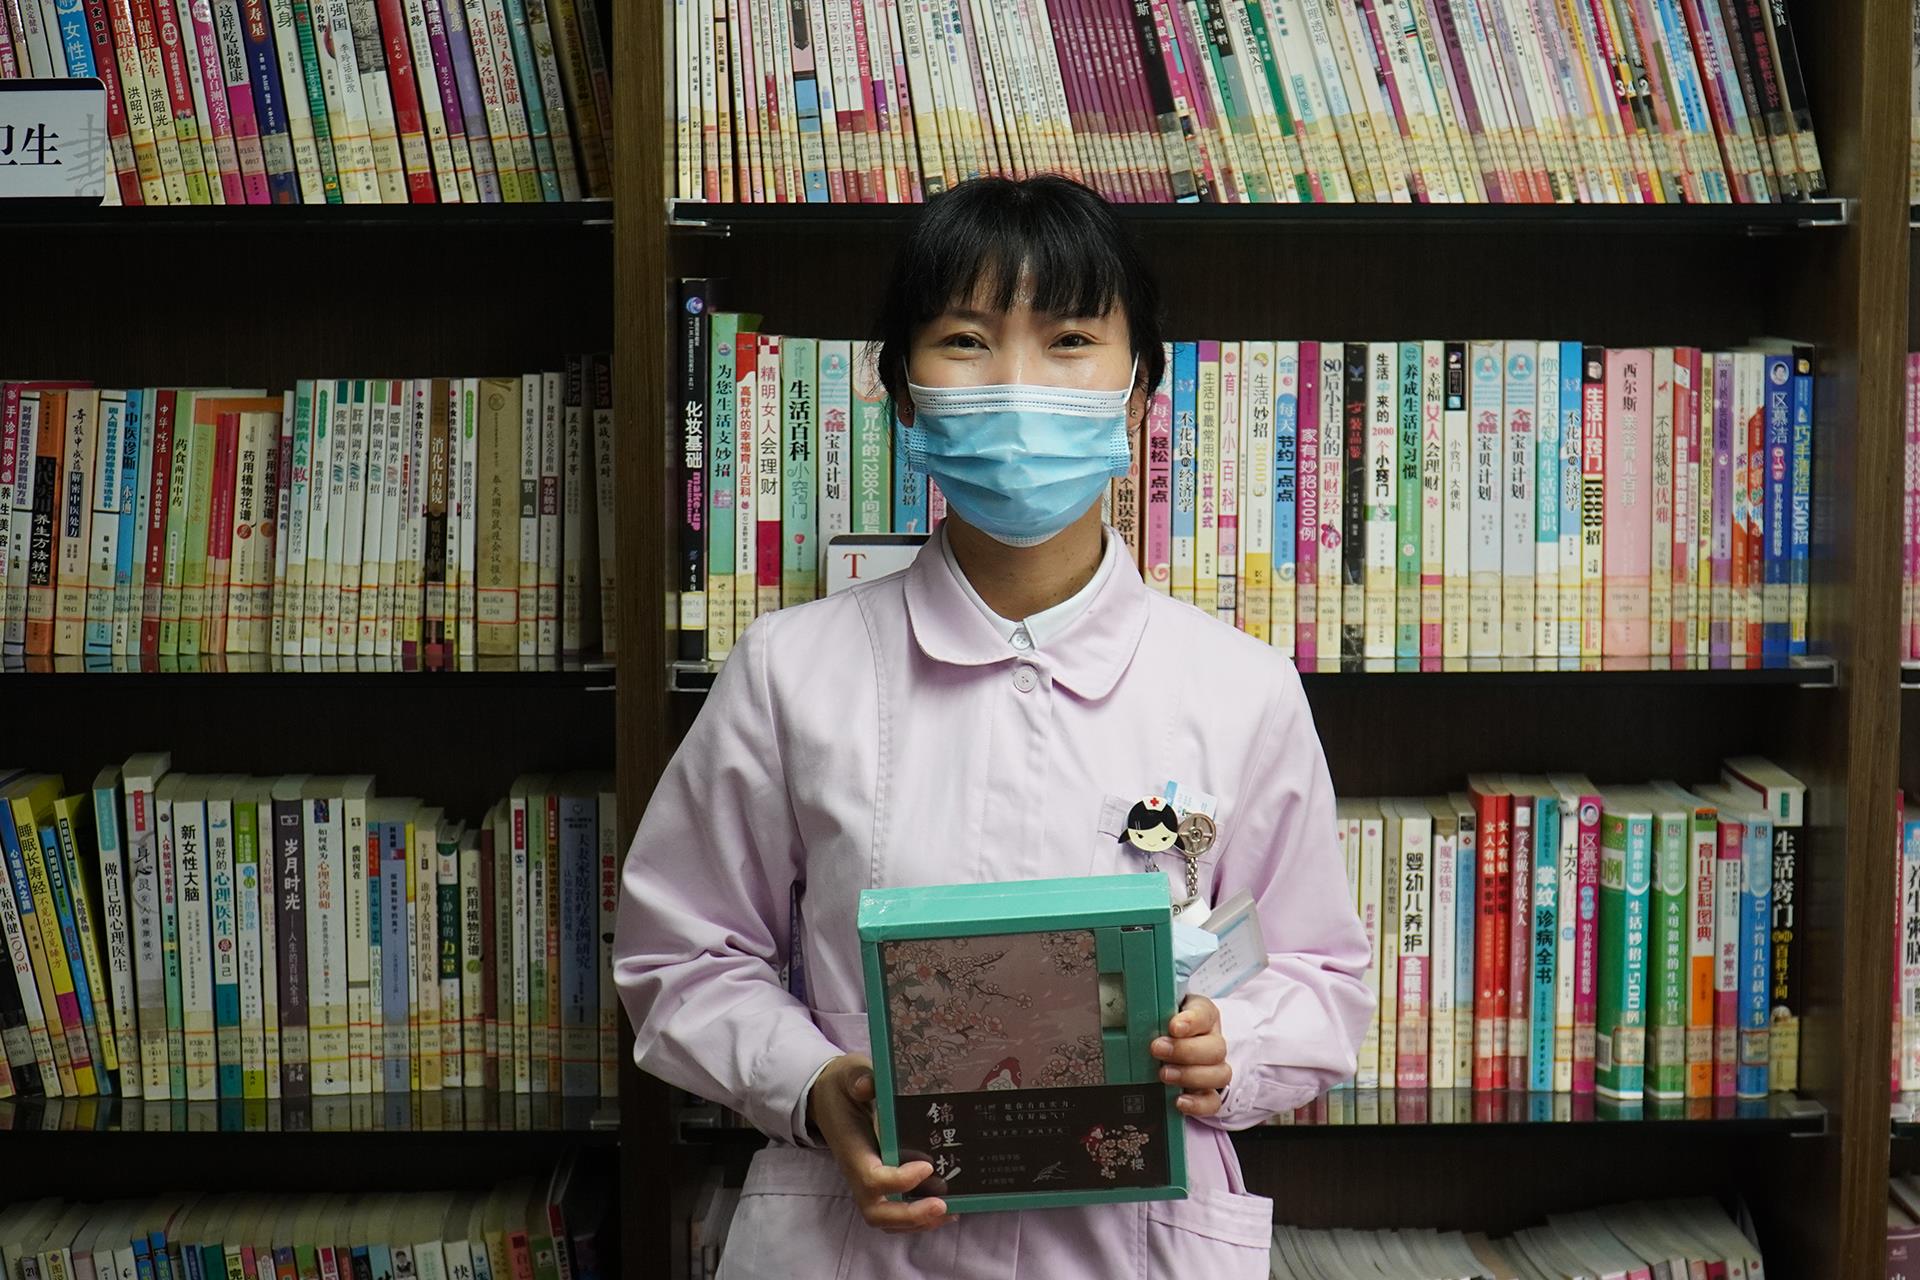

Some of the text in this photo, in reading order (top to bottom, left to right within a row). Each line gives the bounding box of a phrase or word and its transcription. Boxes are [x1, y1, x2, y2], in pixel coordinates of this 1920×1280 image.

[218, 5, 244, 82] 这样吃最健康
[489, 9, 521, 104] 环境与人类健康
[1638, 77, 1651, 96] 2
[127, 86, 147, 126] 洪昭光
[150, 87, 169, 126] 洪昭光
[4, 404, 17, 466] 手诊面诊
[292, 396, 310, 496] 糖尿病病人有救了
[685, 400, 703, 469] 化妆基础
[714, 364, 733, 478] 为您生活支妙招
[740, 386, 752, 497] 高野优的幸福育儿百科
[760, 365, 778, 496] 精明女人会理财
[787, 380, 811, 520] 生活百科小窍门
[1151, 400, 1169, 503] 每天轻松一点点
[1202, 372, 1215, 528] 生活中最常用的计算公式
[1222, 372, 1238, 512] 育儿小百科
[1253, 374, 1270, 438] 生活妙招
[1276, 402, 1295, 502] 每天节约一点点
[1322, 359, 1342, 514] 80后小主妇的理财经
[1371, 353, 1395, 498] 生活中来的2000个小窍门
[1402, 364, 1418, 480] 养成生活好习惯
[1424, 372, 1441, 492] 幸福女人会理财
[1541, 357, 1558, 532] 你不可不知的生活常识
[1584, 386, 1605, 473] 生活小窍门
[1771, 391, 1788, 445] 区慕洁
[68, 472, 81, 538] 解密中医处方
[121, 411, 139, 514] 中医诊断一本通
[172, 438, 188, 508] 药食两用中药
[239, 450, 256, 521] 药用植物花谱
[263, 448, 279, 520] 药用植物花谱
[432, 437, 444, 505] 消化内镜
[692, 471, 702, 532] make-up
[1177, 410, 1195, 513] 不花钱的经济学
[1300, 428, 1318, 541] 家有妙招2000例
[1564, 410, 1582, 512] 不花钱的经济学
[1654, 416, 1669, 523] 不花钱也优雅
[30, 513, 51, 585] 养生方法精华
[843, 553, 866, 578] T
[18, 822, 47, 896] 睡眠长寿经
[181, 825, 200, 903] 新女性大脑
[214, 837, 233, 978] 最好的心理医生是自己
[284, 839, 300, 911] 岁月时光
[317, 828, 331, 910] 如何成为心理咨询师
[1404, 852, 1424, 952] 婴幼儿养护
[1773, 831, 1795, 928] 生活窍门
[104, 862, 128, 973] 做自己的心理医生
[465, 886, 480, 957] 药用植物花谱
[1536, 866, 1556, 985] 掌纹诊病全书
